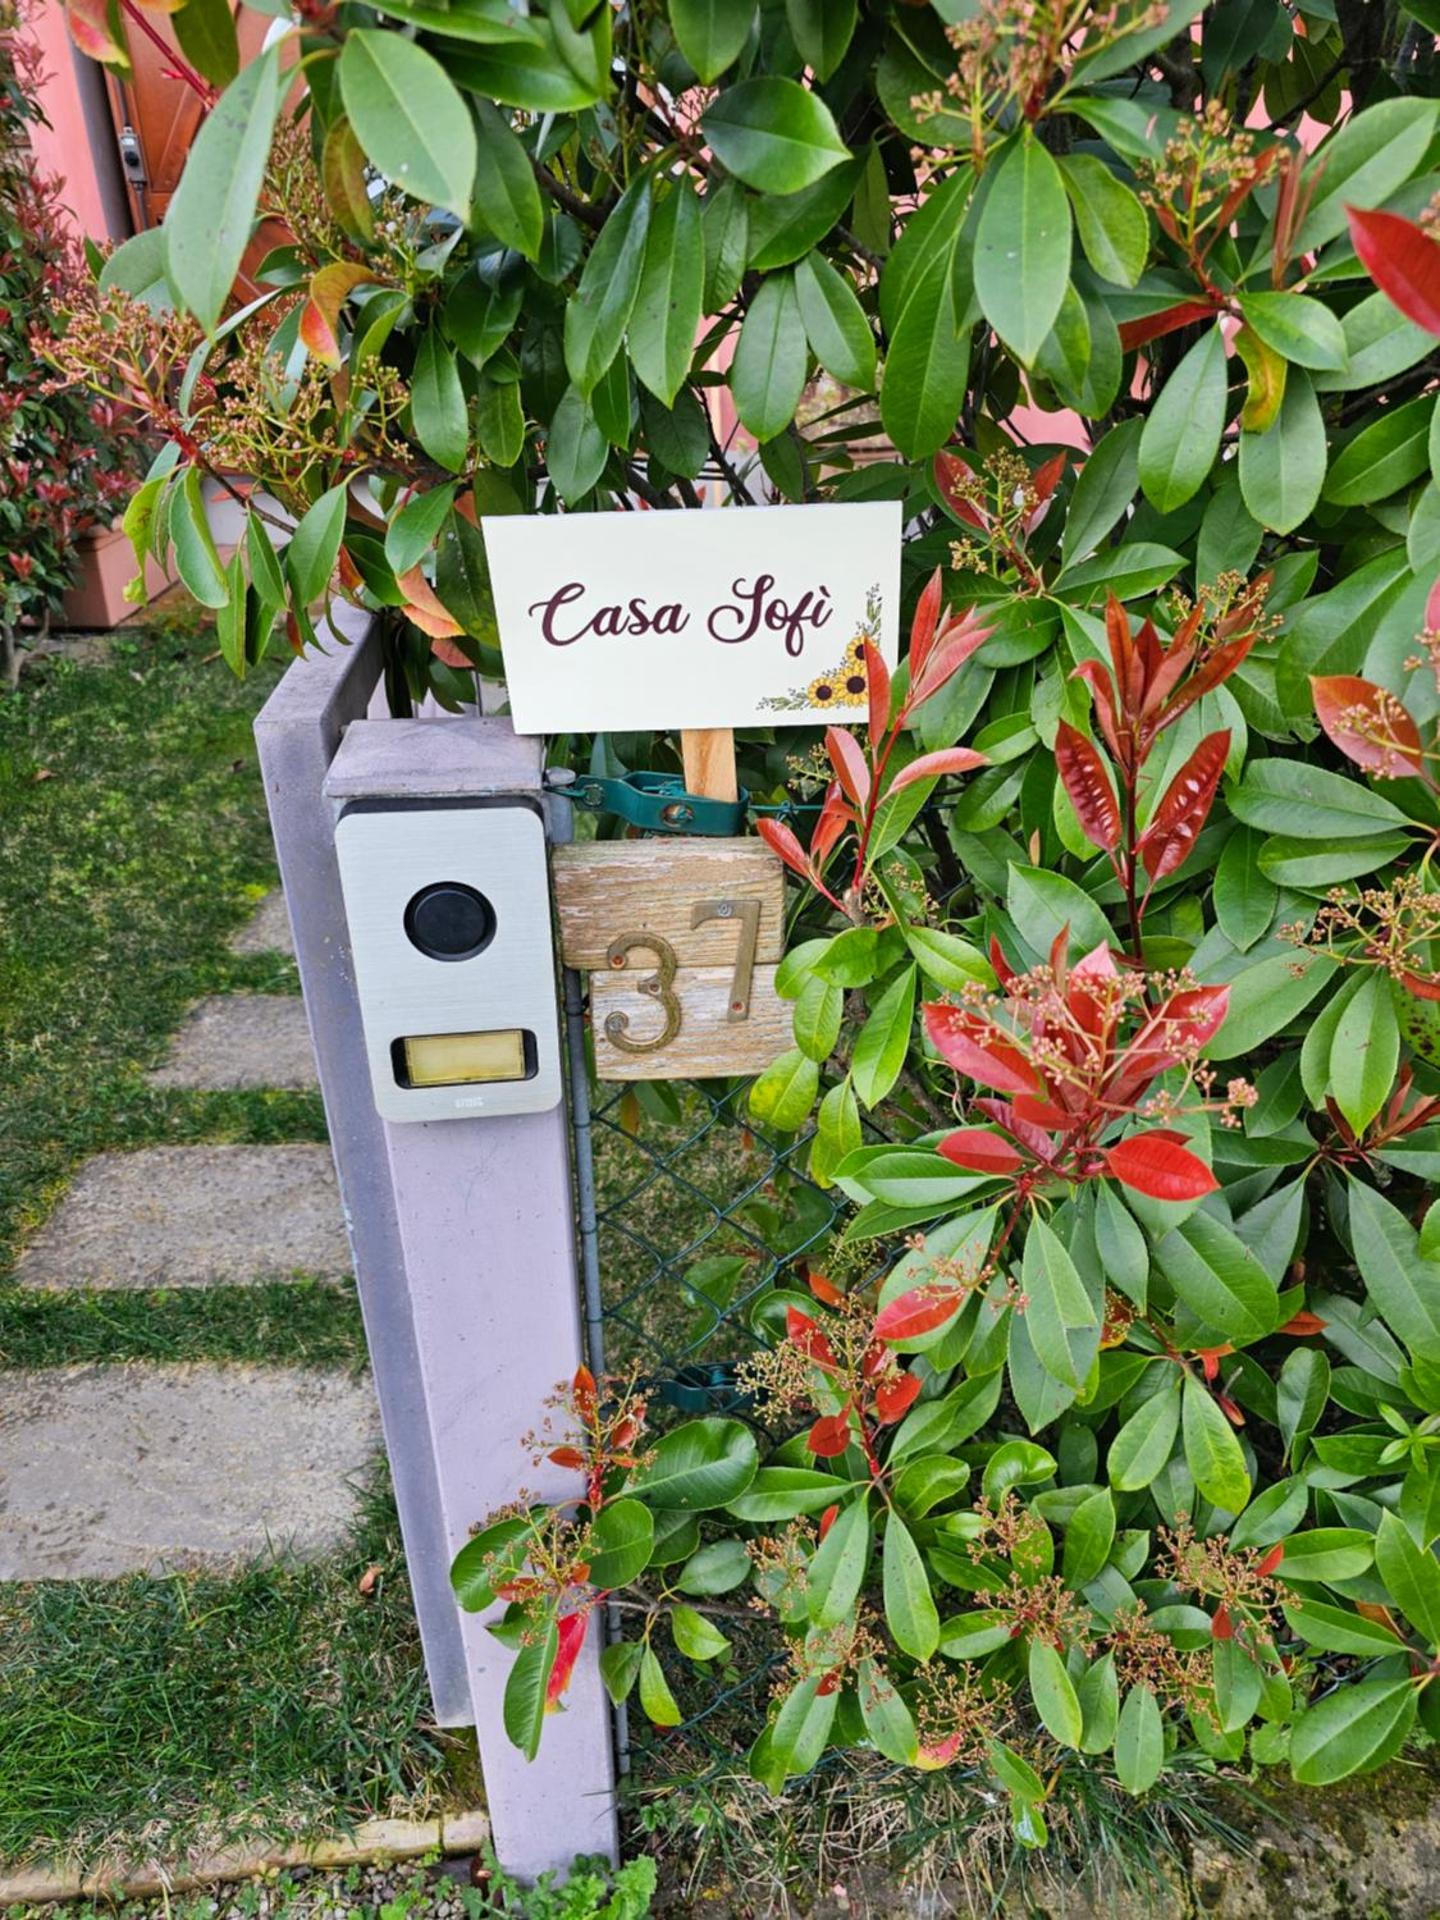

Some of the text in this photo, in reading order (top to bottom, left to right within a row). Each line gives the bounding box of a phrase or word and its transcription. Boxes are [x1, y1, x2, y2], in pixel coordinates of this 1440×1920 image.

[529, 575, 832, 656] Casa Sofì
[605, 900, 761, 1053] 37
